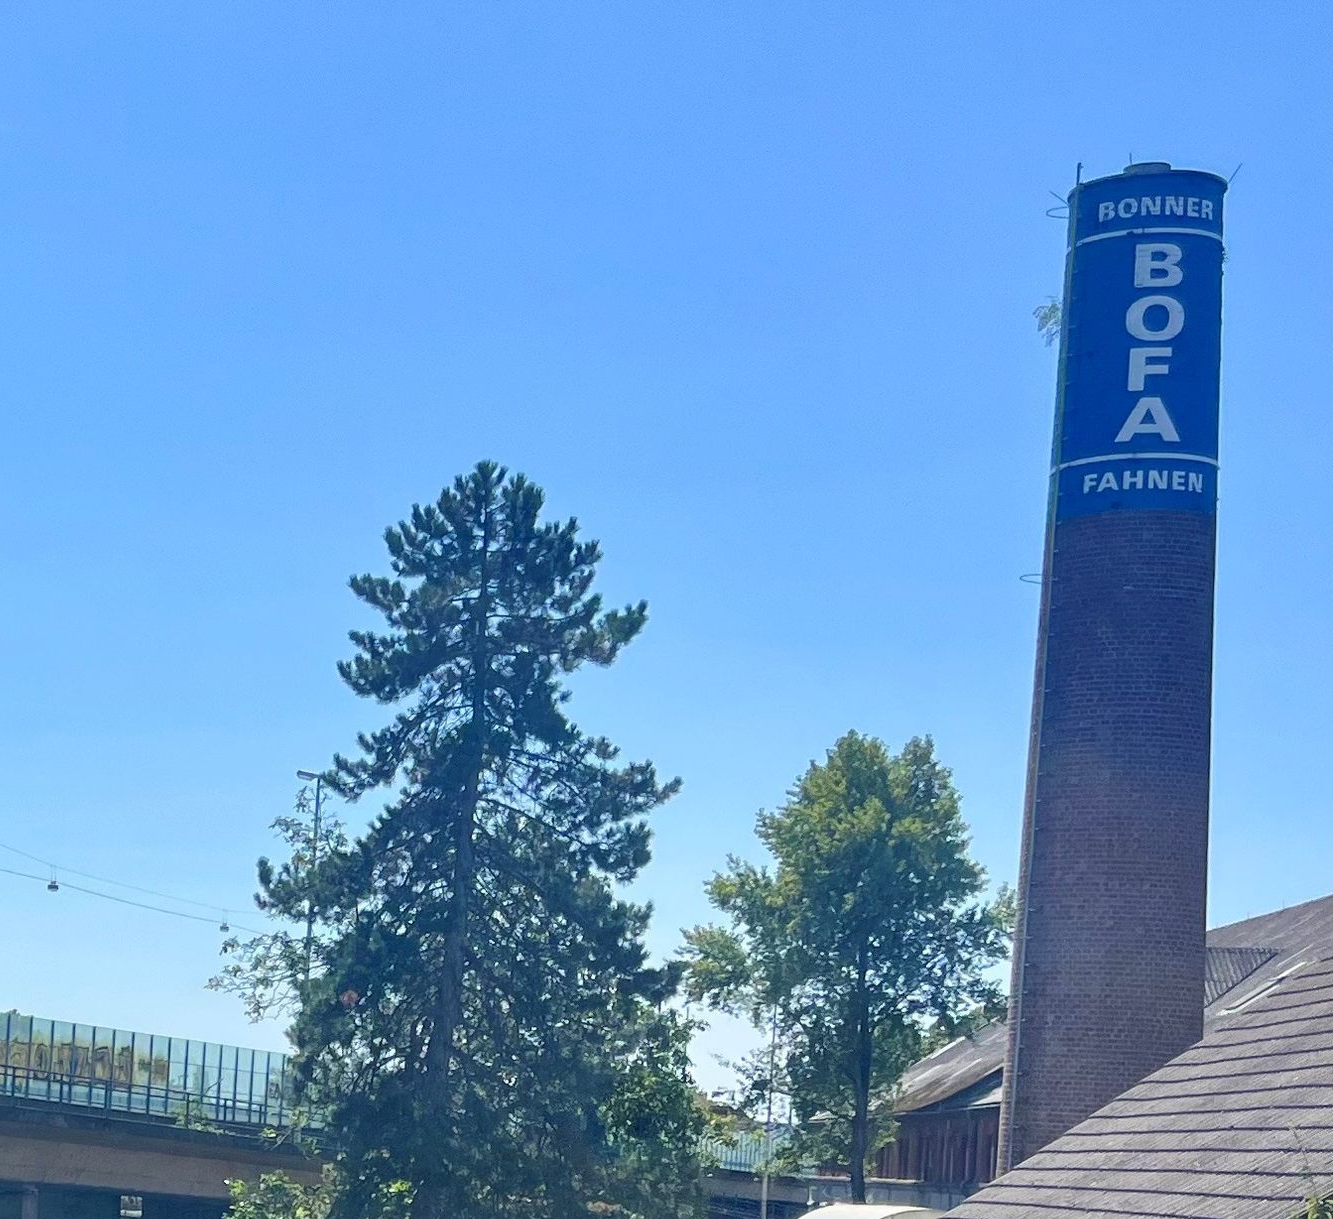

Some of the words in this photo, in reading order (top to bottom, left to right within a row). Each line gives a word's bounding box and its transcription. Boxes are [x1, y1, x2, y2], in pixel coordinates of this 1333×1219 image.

[1098, 196, 1214, 223] BONNER
[1114, 243, 1185, 443] BOFA
[1083, 471, 1204, 494] FAHNEN
